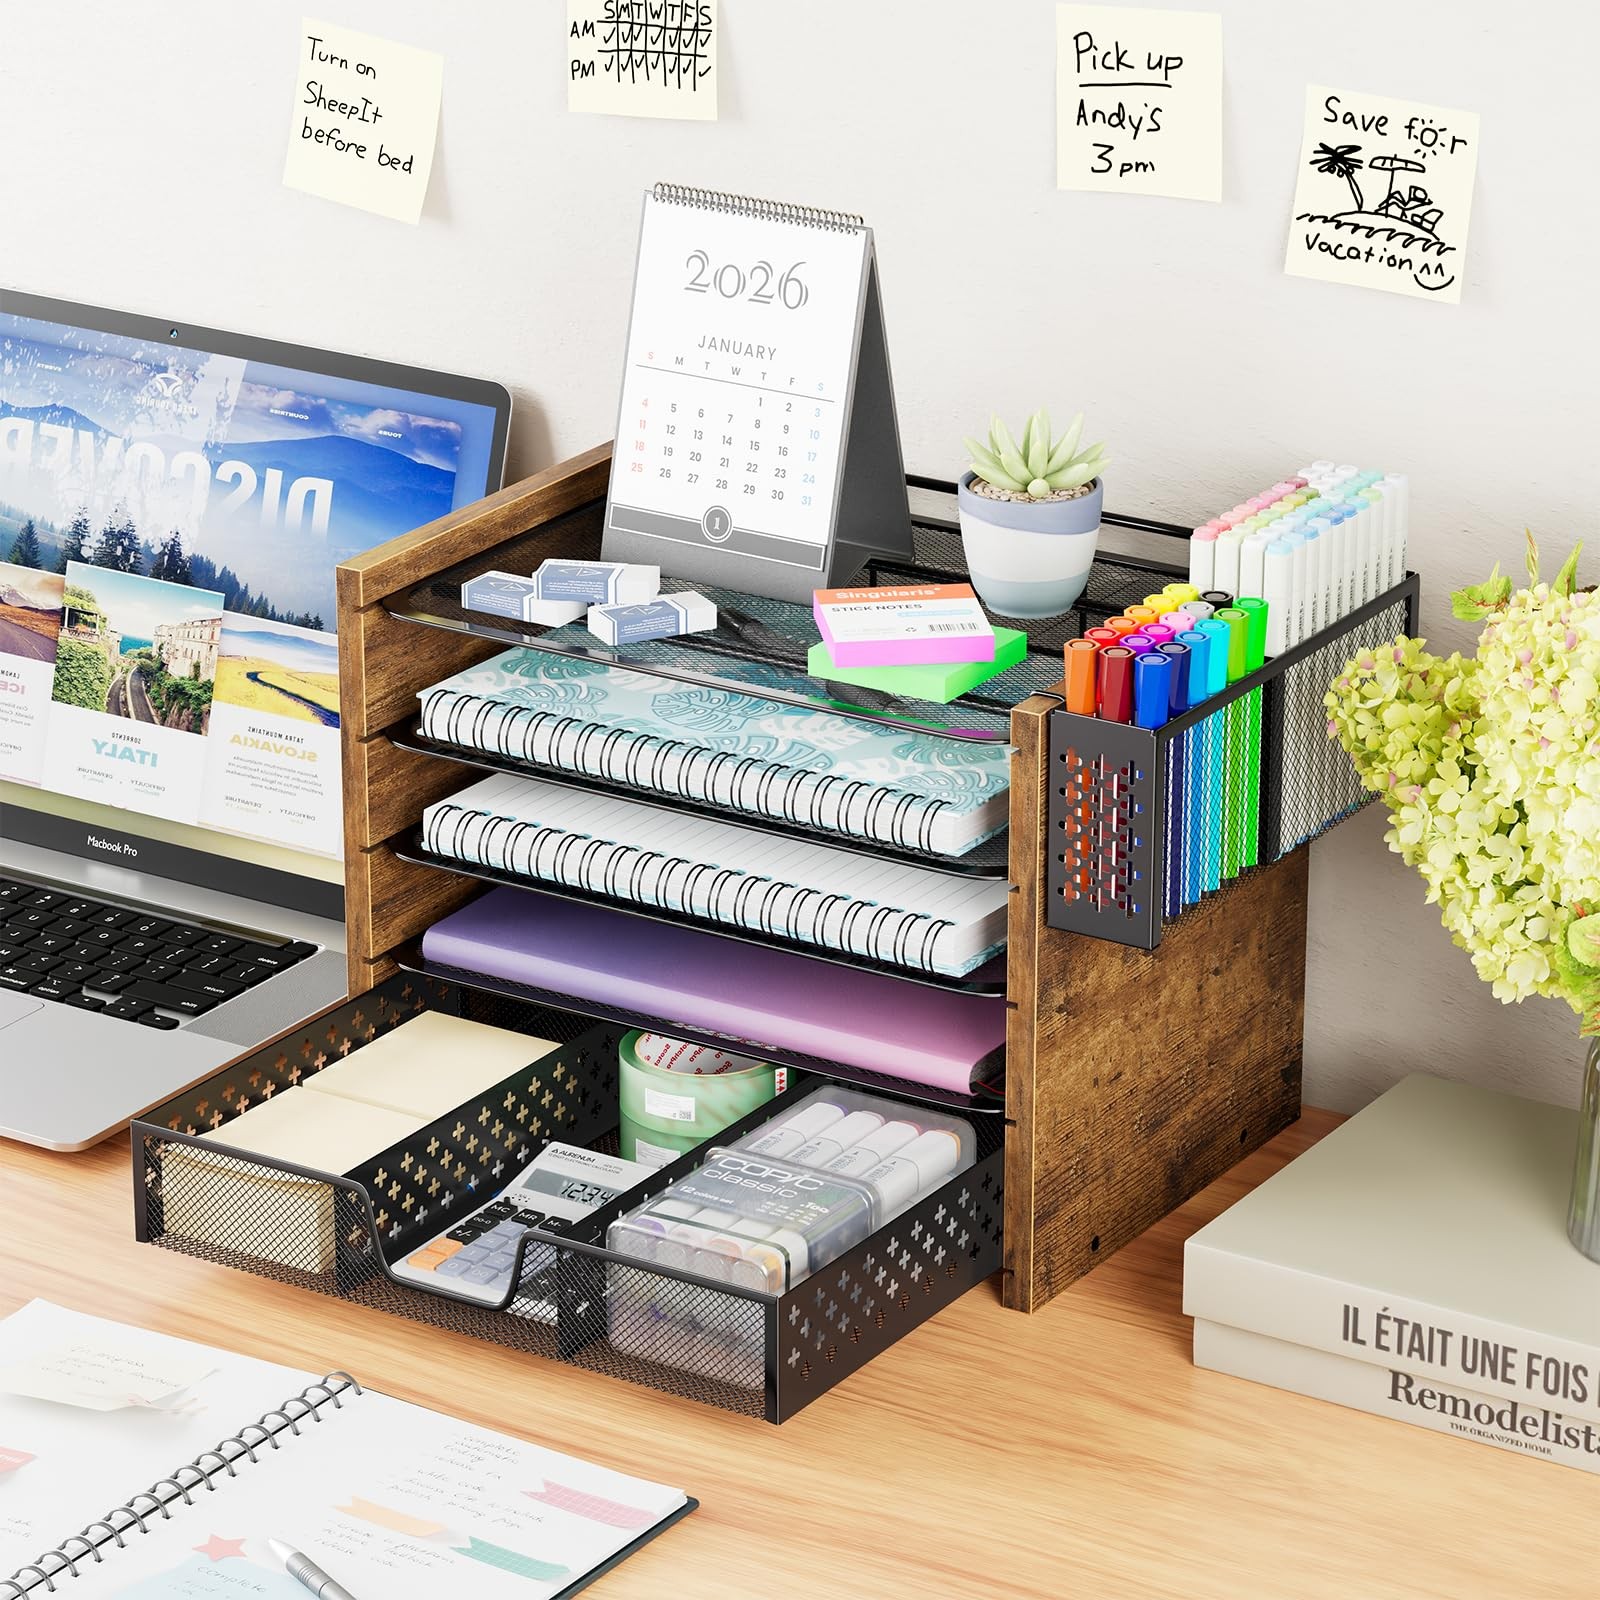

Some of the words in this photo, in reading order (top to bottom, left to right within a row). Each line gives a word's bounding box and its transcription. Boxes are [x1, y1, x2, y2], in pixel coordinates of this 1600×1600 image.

[604, 0, 615, 19] S
[618, 3, 630, 18] M
[632, 2, 643, 19] T
[650, 3, 663, 19] W
[668, 4, 680, 21] T
[684, 3, 695, 22] F
[700, 6, 712, 25] S
[570, 20, 595, 38] AM
[307, 35, 348, 70] Turn
[355, 63, 377, 80] on
[571, 60, 595, 80] PM
[1072, 31, 1135, 74] Pick
[1146, 52, 1184, 82] up
[303, 80, 383, 126] SheepIt
[1323, 95, 1389, 137] Save
[1076, 98, 1163, 141] Andy's
[301, 115, 370, 160] before
[377, 143, 414, 175] bed
[1090, 142, 1115, 174] 3
[1119, 160, 1156, 178] pm
[1305, 229, 1415, 271] vacation
[683, 249, 809, 310] 2026
[697, 335, 777, 361] JANUARY
[647, 351, 654, 360] S
[674, 355, 684, 366] M
[704, 360, 711, 371] T
[731, 366, 741, 377] W
[760, 371, 768, 381] T
[789, 376, 796, 386] F
[817, 382, 824, 392] S
[641, 398, 649, 408] 4
[670, 402, 677, 413] 5
[697, 408, 705, 419] 6
[727, 413, 734, 424] 7
[754, 418, 761, 430] 8
[783, 424, 790, 435] 9
[809, 429, 820, 440] 10
[758, 396, 763, 408] 1
[785, 401, 792, 413] 2
[814, 407, 821, 418] 3
[639, 419, 647, 430] 11
[666, 424, 676, 436] 12
[693, 429, 704, 441] 13
[722, 434, 733, 447] 14
[749, 440, 760, 452] 15
[778, 445, 789, 457] 16
[807, 451, 817, 462] 17
[635, 440, 645, 452] 18
[663, 445, 674, 457] 19
[689, 450, 702, 463] 20
[719, 456, 730, 468] 21
[745, 461, 759, 474] 22
[774, 467, 787, 479] 23
[802, 473, 815, 484] 24
[631, 462, 644, 473] 25
[659, 467, 672, 479] 26
[687, 472, 700, 484] 27
[715, 478, 728, 490] 28
[743, 483, 756, 495] 29
[770, 489, 785, 501] 30
[801, 495, 812, 506] 31
[831, 605, 873, 613] STICK
[876, 603, 923, 611] NOTES
[835, 589, 935, 600] Singularis
[87, 834, 122, 854] Macbook
[123, 843, 139, 859] Pro
[257, 957, 278, 965] delete
[38, 986, 60, 995] option
[181, 1001, 198, 1009] shift
[203, 985, 225, 994] return
[561, 1183, 614, 1205] 1234
[679, 1185, 694, 1194] 12
[702, 1169, 798, 1198] classic
[491, 1204, 510, 1213] MC
[519, 1212, 538, 1221] MR
[1342, 1303, 1366, 1346] IL
[1375, 1306, 1454, 1367] ÉTAIT
[1461, 1335, 1518, 1386] UNE
[1525, 1351, 1589, 1403] FOIS
[1387, 1368, 1600, 1454] Remodelist
[1450, 1422, 1468, 1432] THE
[1470, 1428, 1524, 1446] ORGANIZED
[1524, 1441, 1552, 1455] HOME
